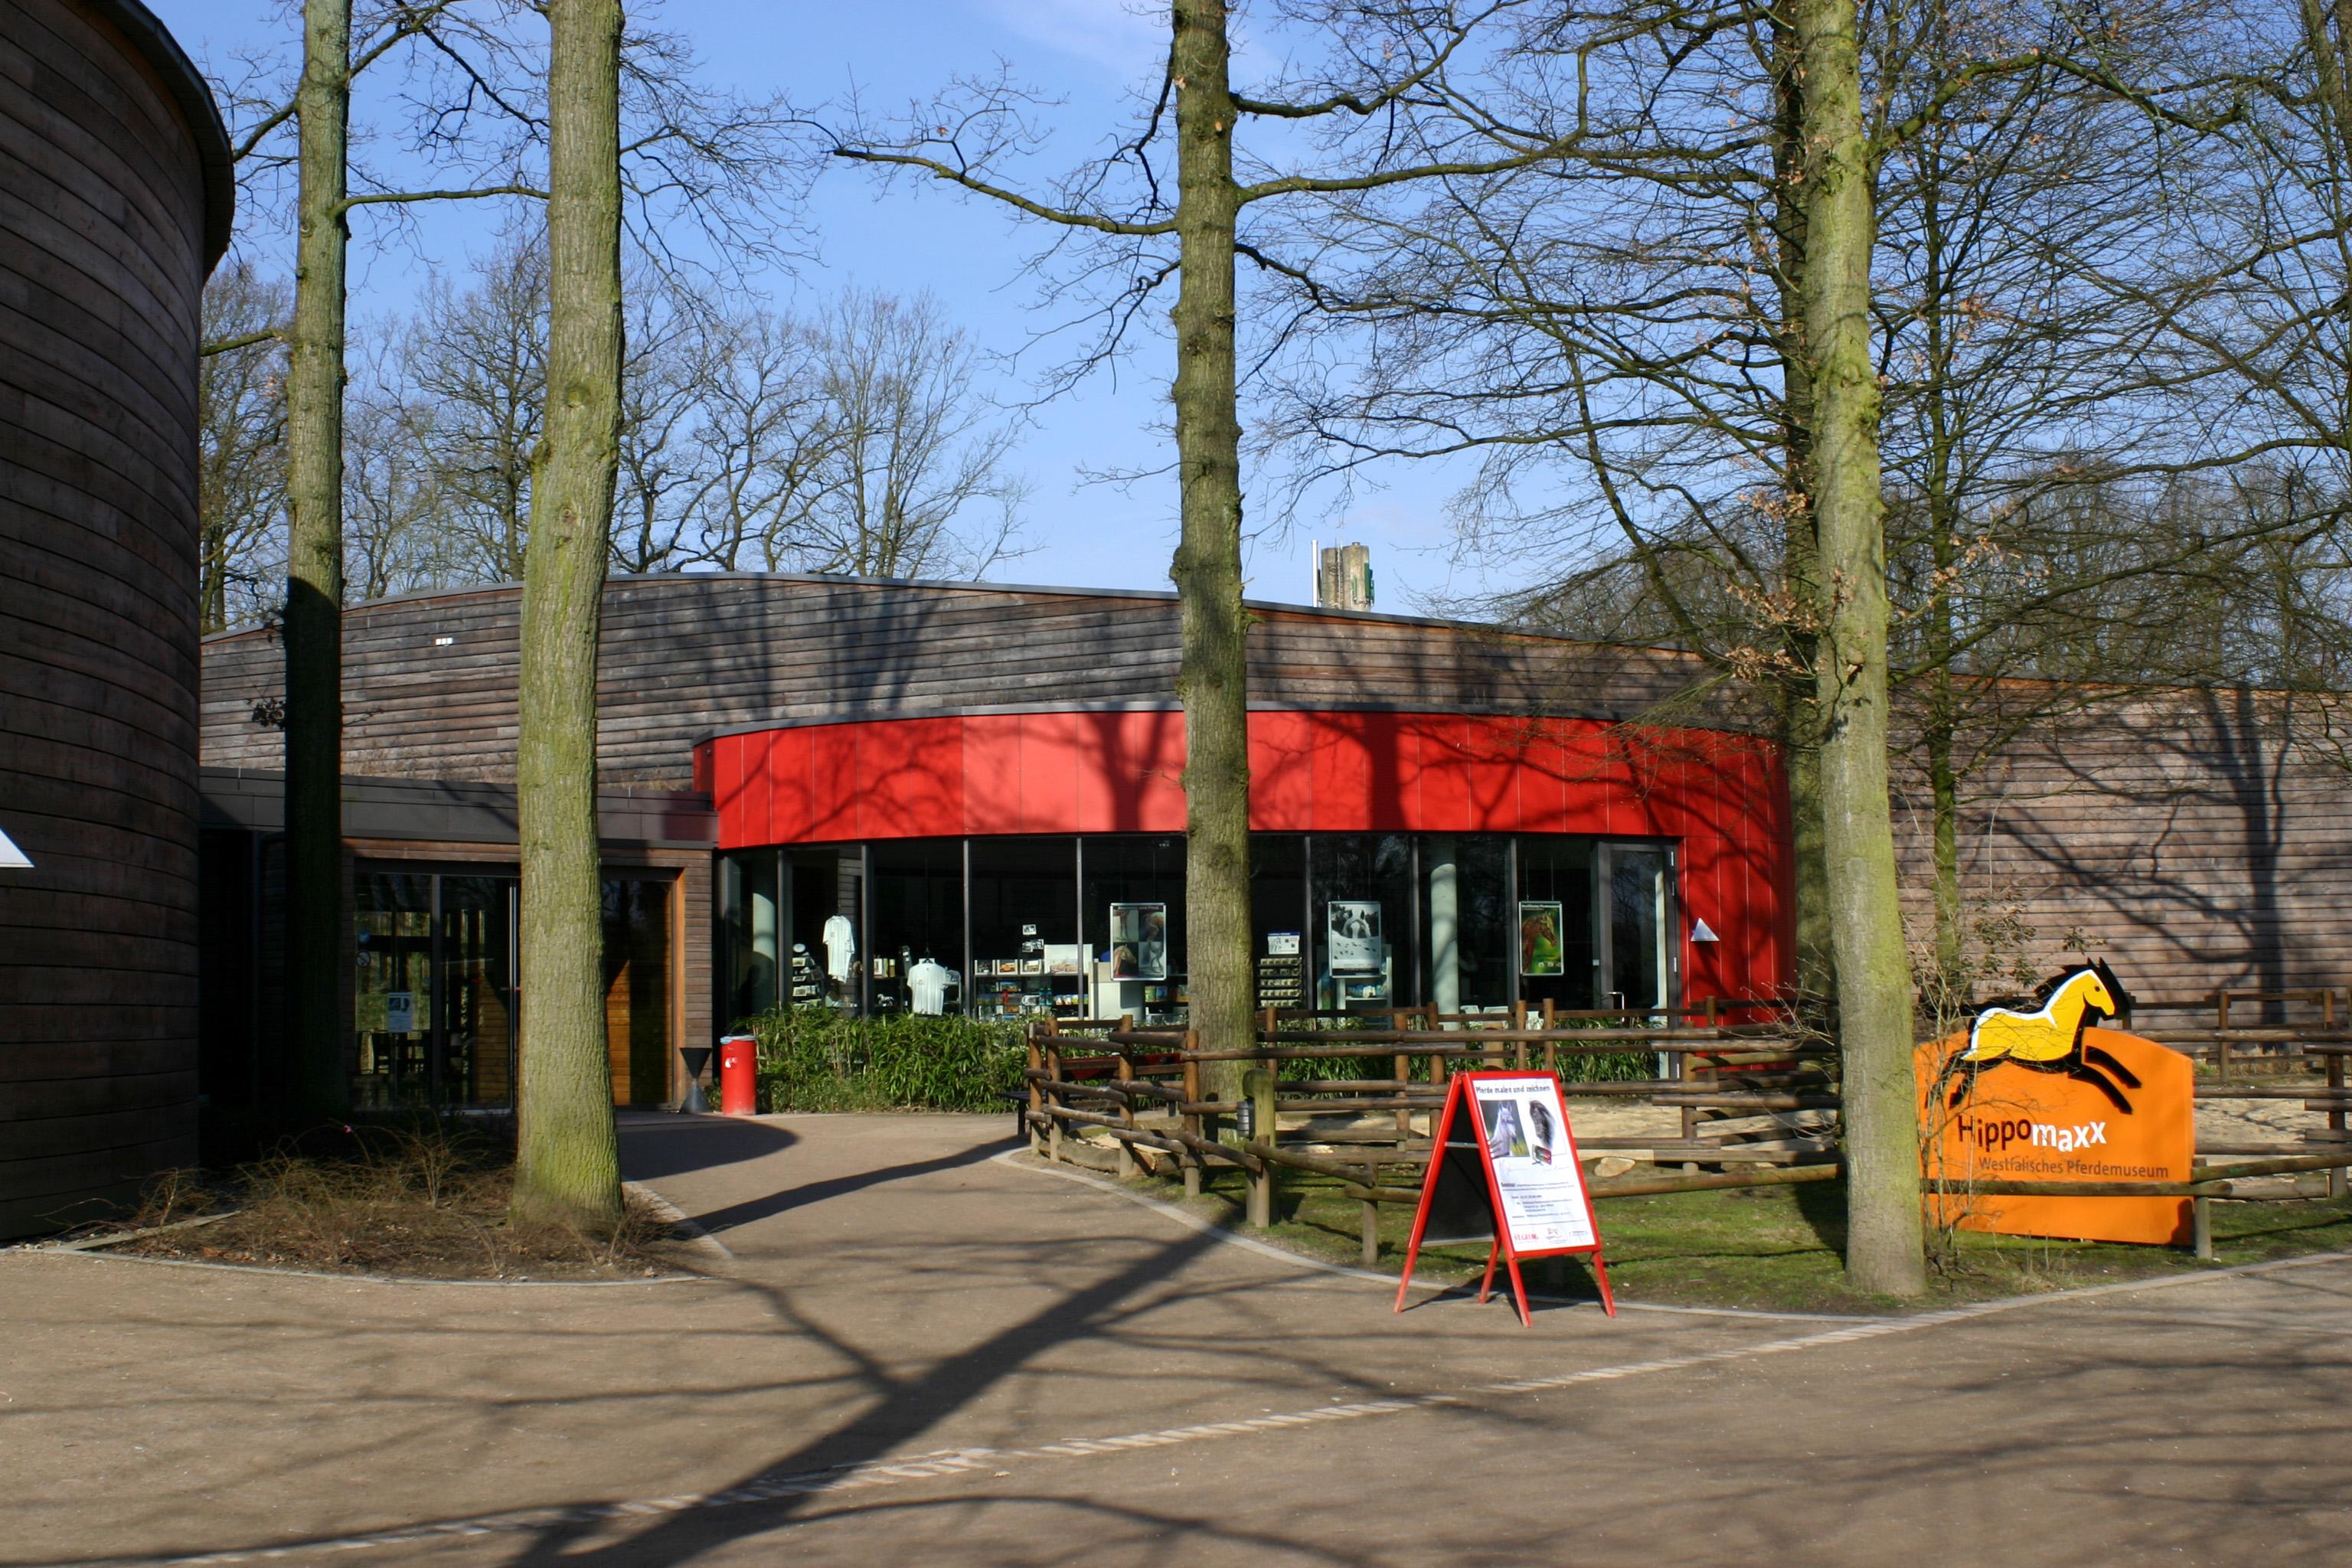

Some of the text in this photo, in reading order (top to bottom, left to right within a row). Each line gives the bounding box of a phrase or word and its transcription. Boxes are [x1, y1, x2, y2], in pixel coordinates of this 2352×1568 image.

[1475, 1086, 1493, 1094] Pferde
[1494, 1085, 1512, 1094] malen
[1527, 1084, 1550, 1093] zeichnen
[1978, 1155, 2169, 1178] Westfälisches Pferdemuseum
